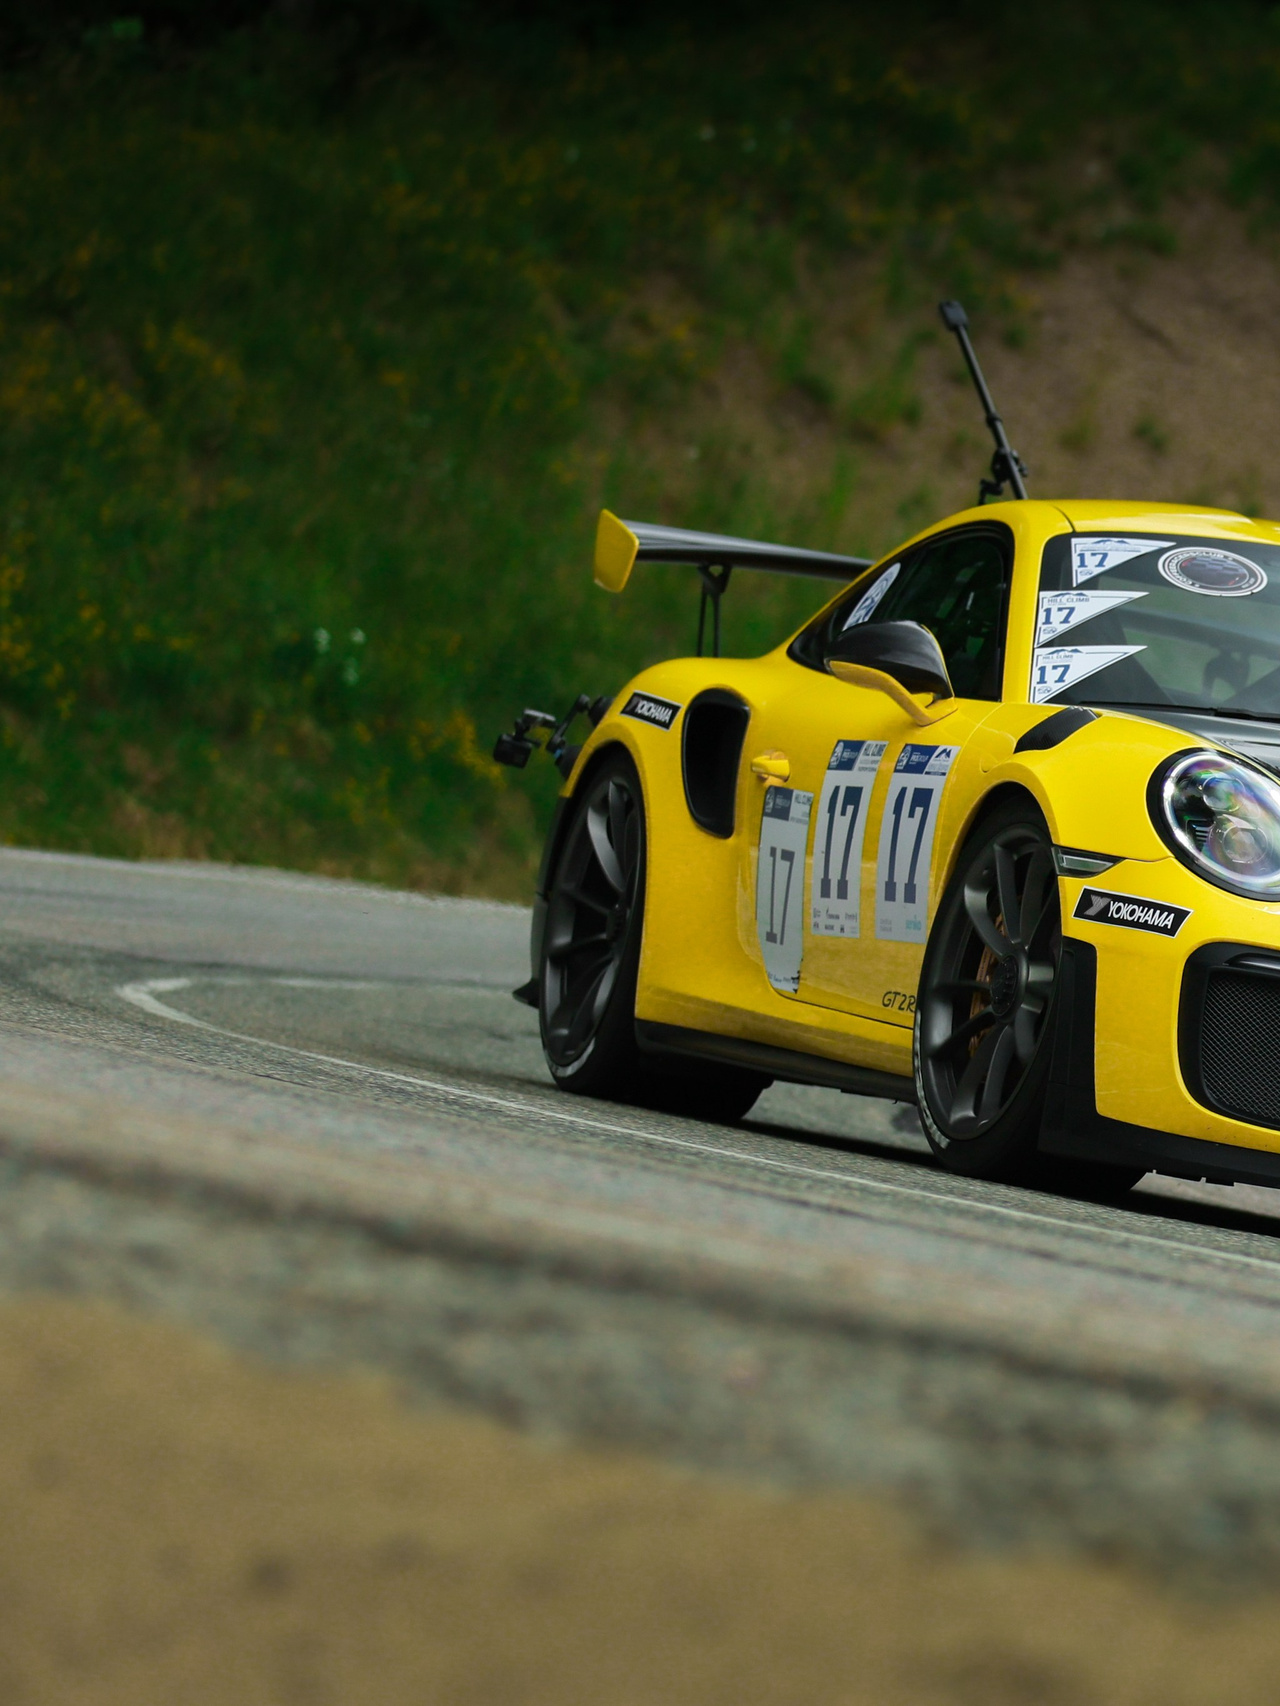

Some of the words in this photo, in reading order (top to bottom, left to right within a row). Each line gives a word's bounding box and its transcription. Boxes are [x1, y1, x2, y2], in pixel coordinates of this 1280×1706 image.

[1077, 552, 1109, 569] 17
[1042, 606, 1076, 625] 17
[1036, 664, 1071, 684] 17
[634, 699, 673, 724] YOKOHAMA
[820, 785, 864, 900] 17
[884, 786, 934, 904] 17
[765, 846, 796, 946] 17
[1107, 900, 1175, 929] YOKOHAMA
